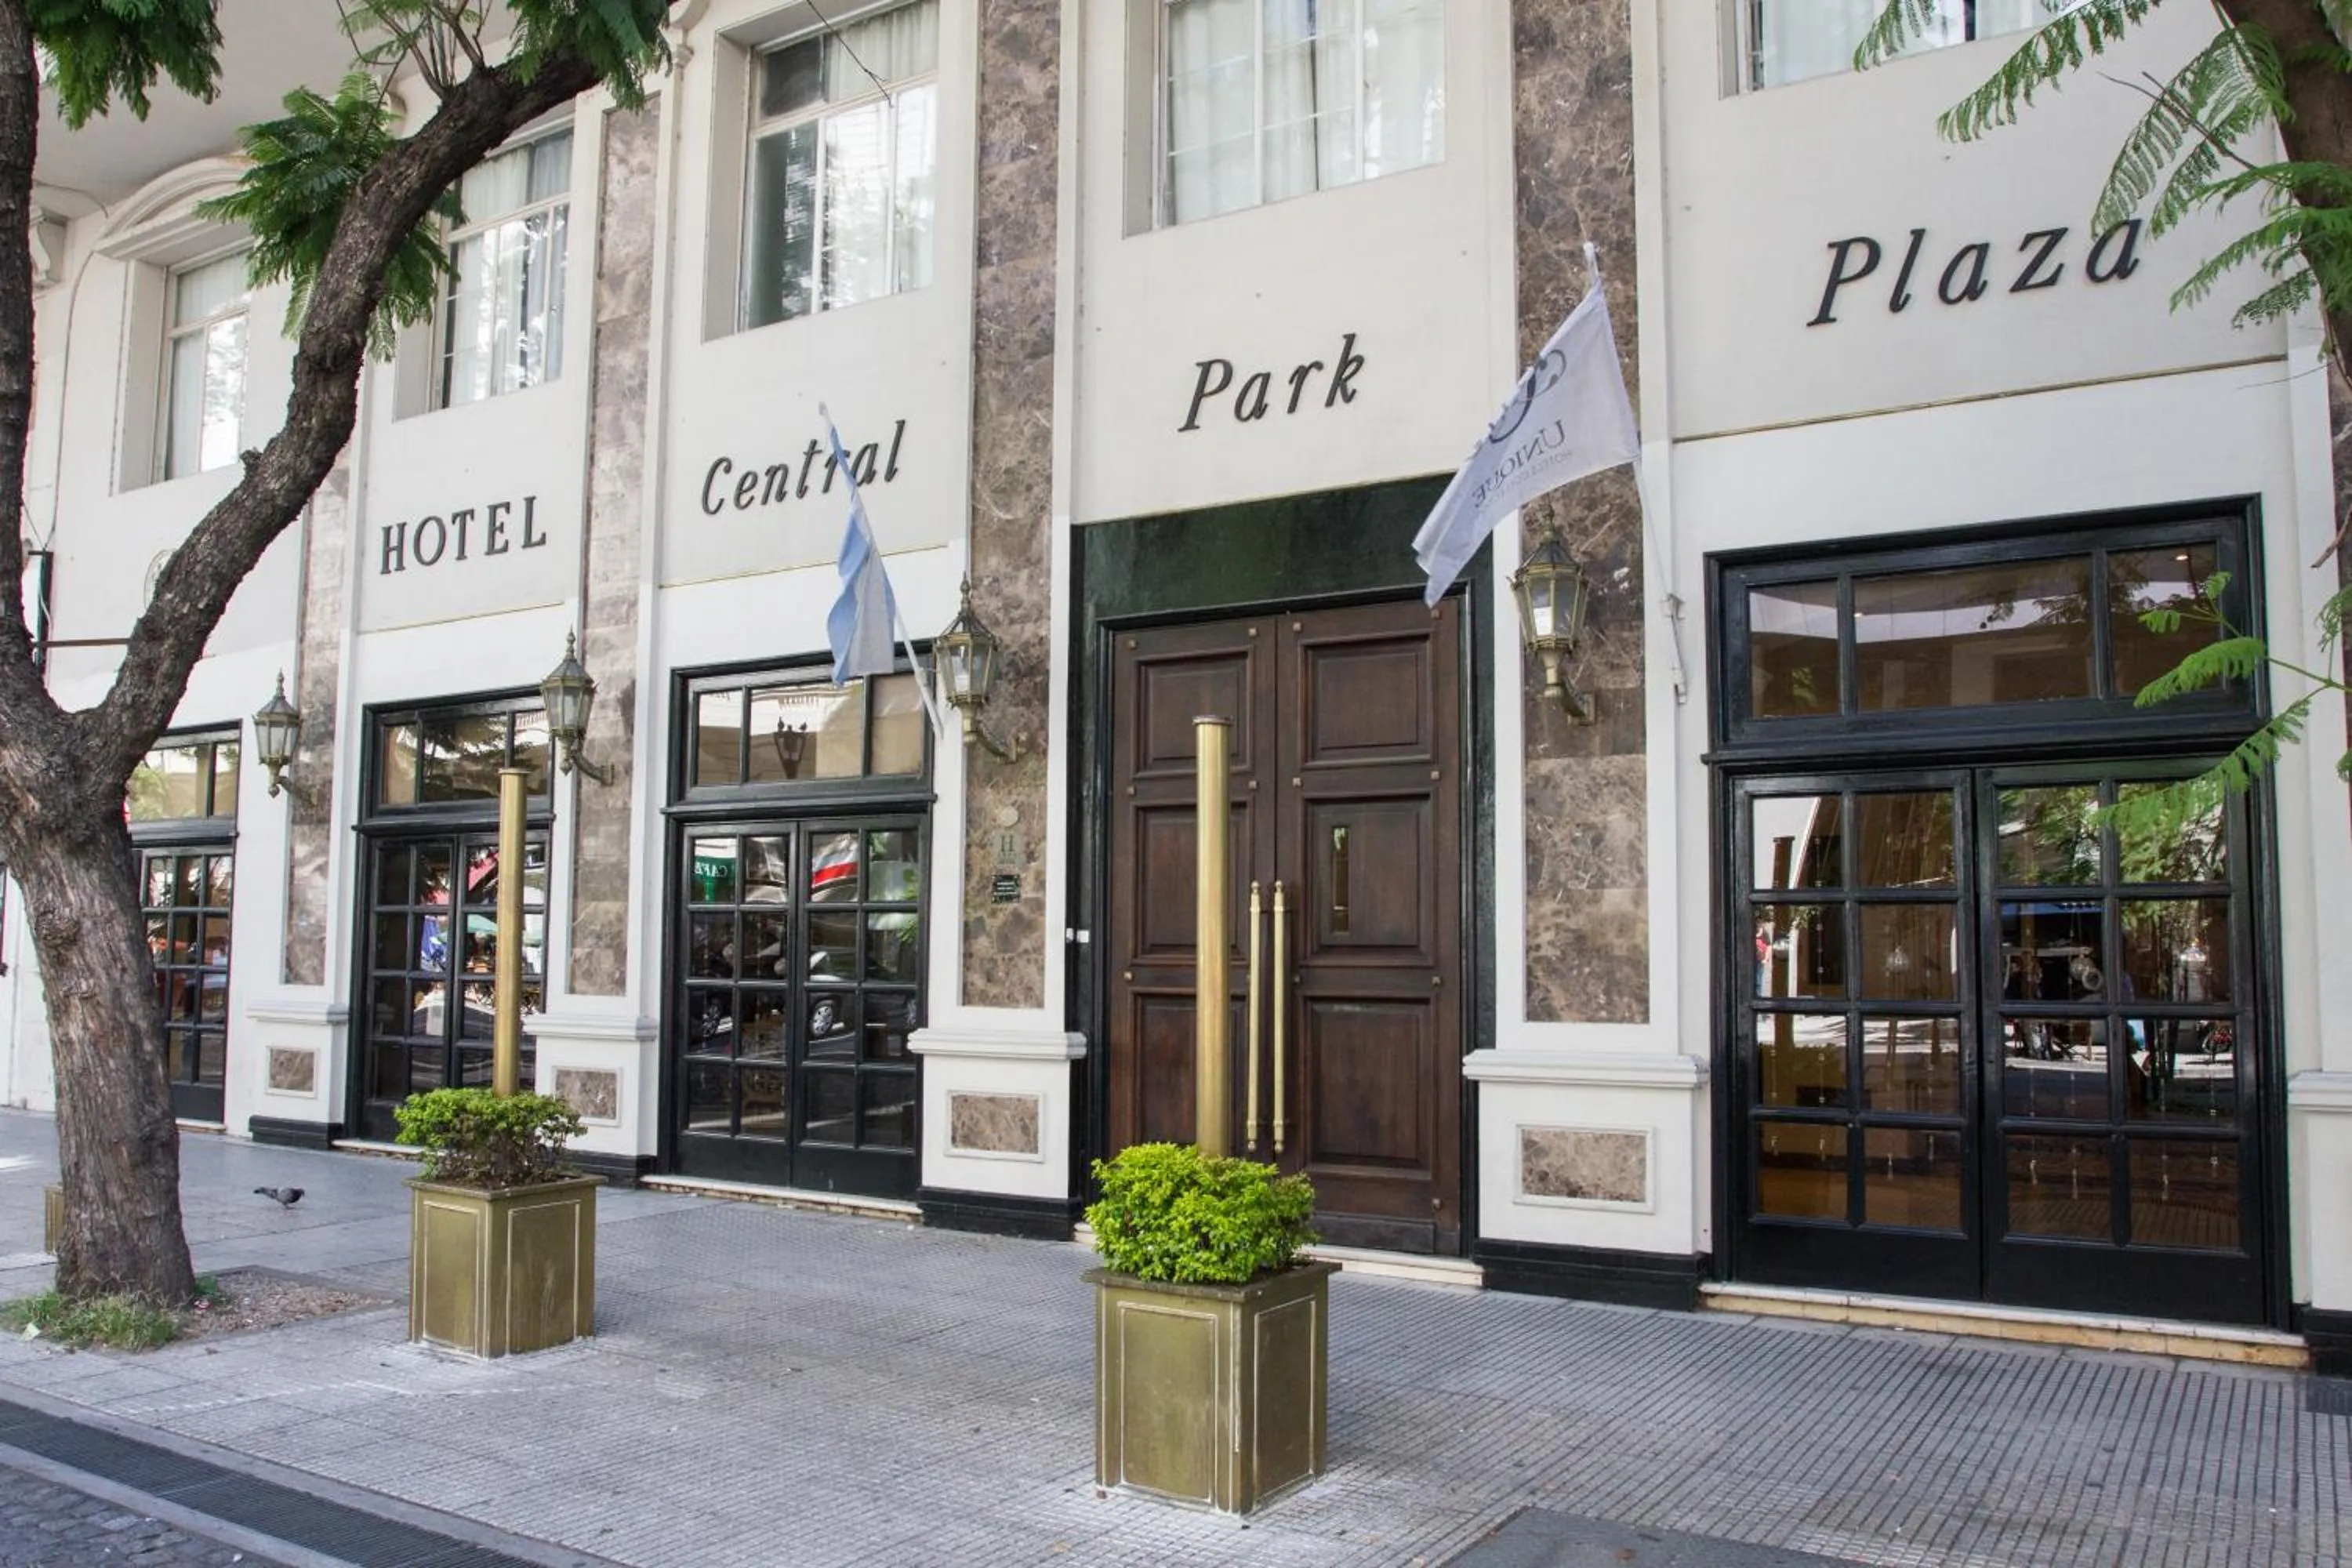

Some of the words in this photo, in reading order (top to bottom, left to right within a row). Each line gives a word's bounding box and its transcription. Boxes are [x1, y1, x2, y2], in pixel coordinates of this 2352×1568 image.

[380, 495, 546, 575] HOTEL
[702, 419, 906, 515] Central
[1177, 332, 1364, 432] Park
[1806, 219, 2142, 327] Plaza
